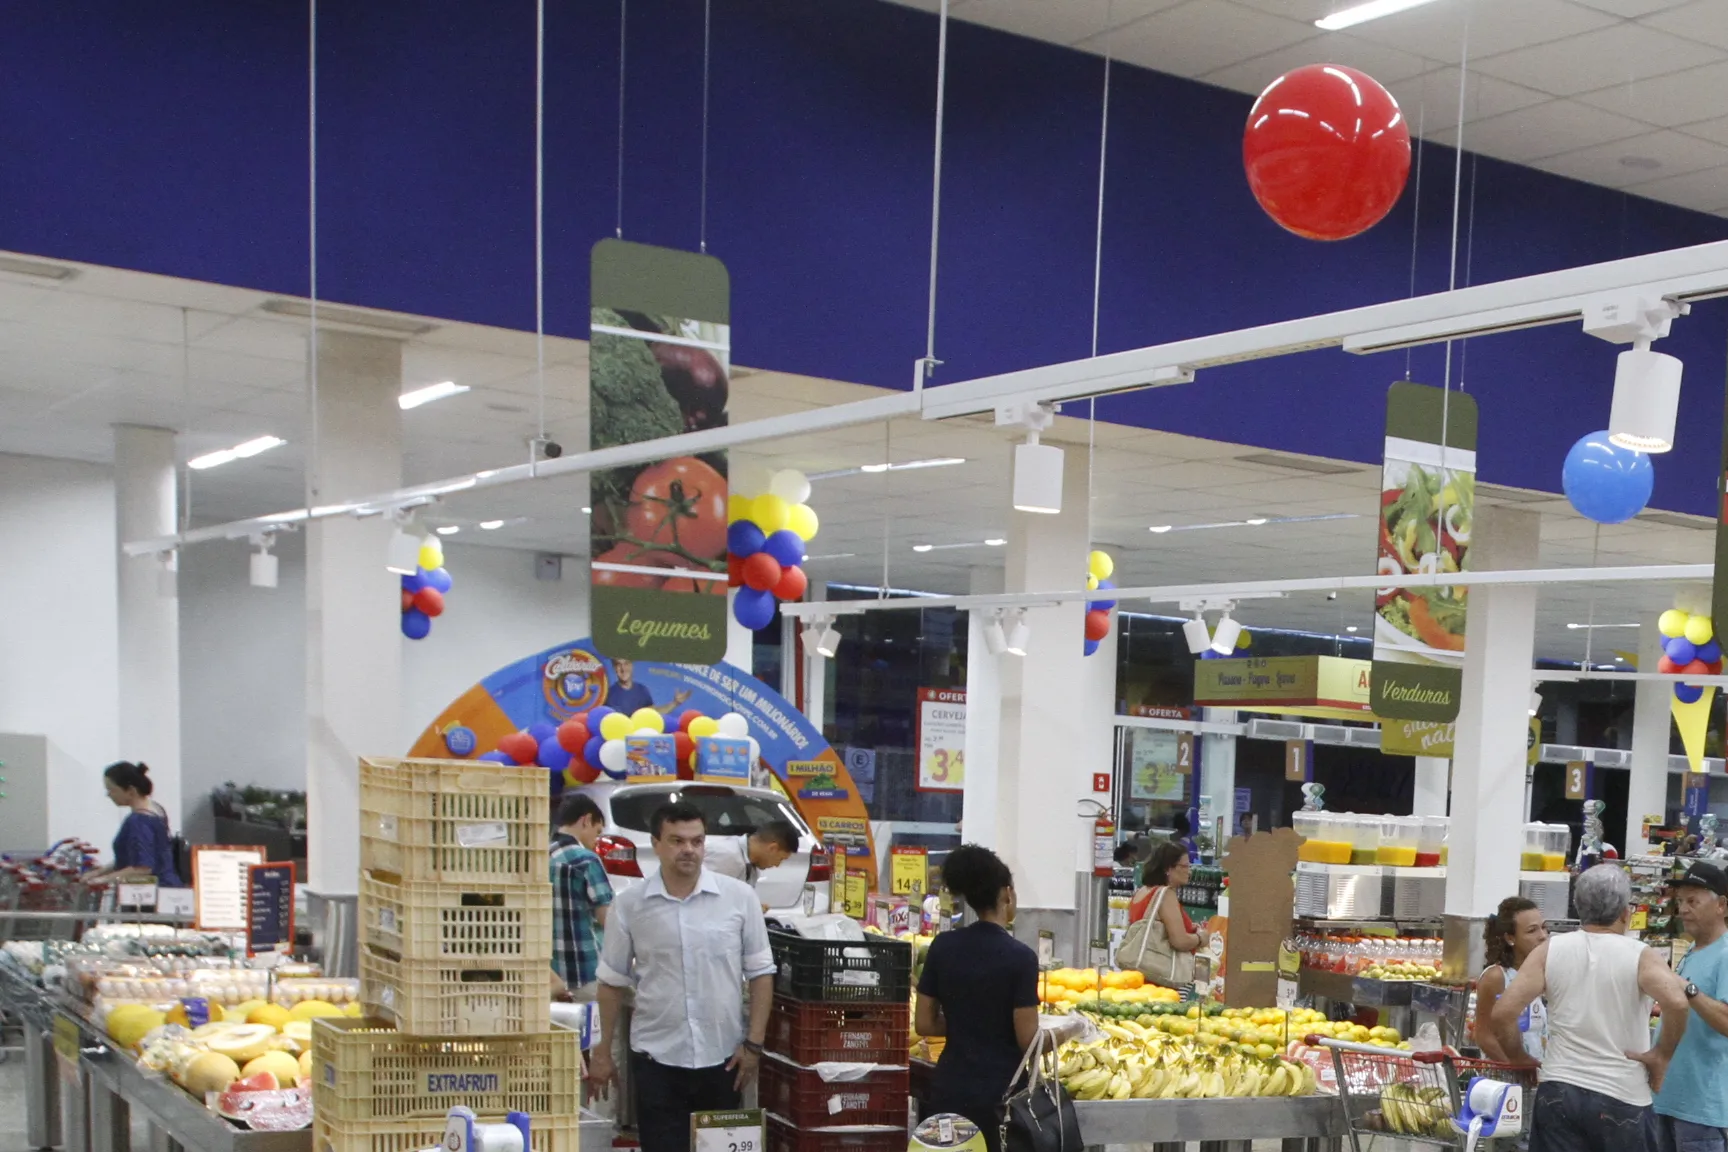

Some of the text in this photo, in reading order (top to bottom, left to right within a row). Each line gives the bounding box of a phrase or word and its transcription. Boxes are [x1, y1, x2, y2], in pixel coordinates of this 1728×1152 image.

[616, 611, 712, 648] Legumes
[709, 668, 720, 682] DE
[720, 675, 741, 694] SER
[1382, 680, 1451, 705] Verduras
[1149, 708, 1182, 718] OFERTA
[1180, 742, 1189, 766] 2
[1293, 747, 1299, 772] 1
[1570, 768, 1581, 792] 3
[828, 821, 866, 831] CARROS
[427, 1074, 498, 1093] EXTRAFRUTI
